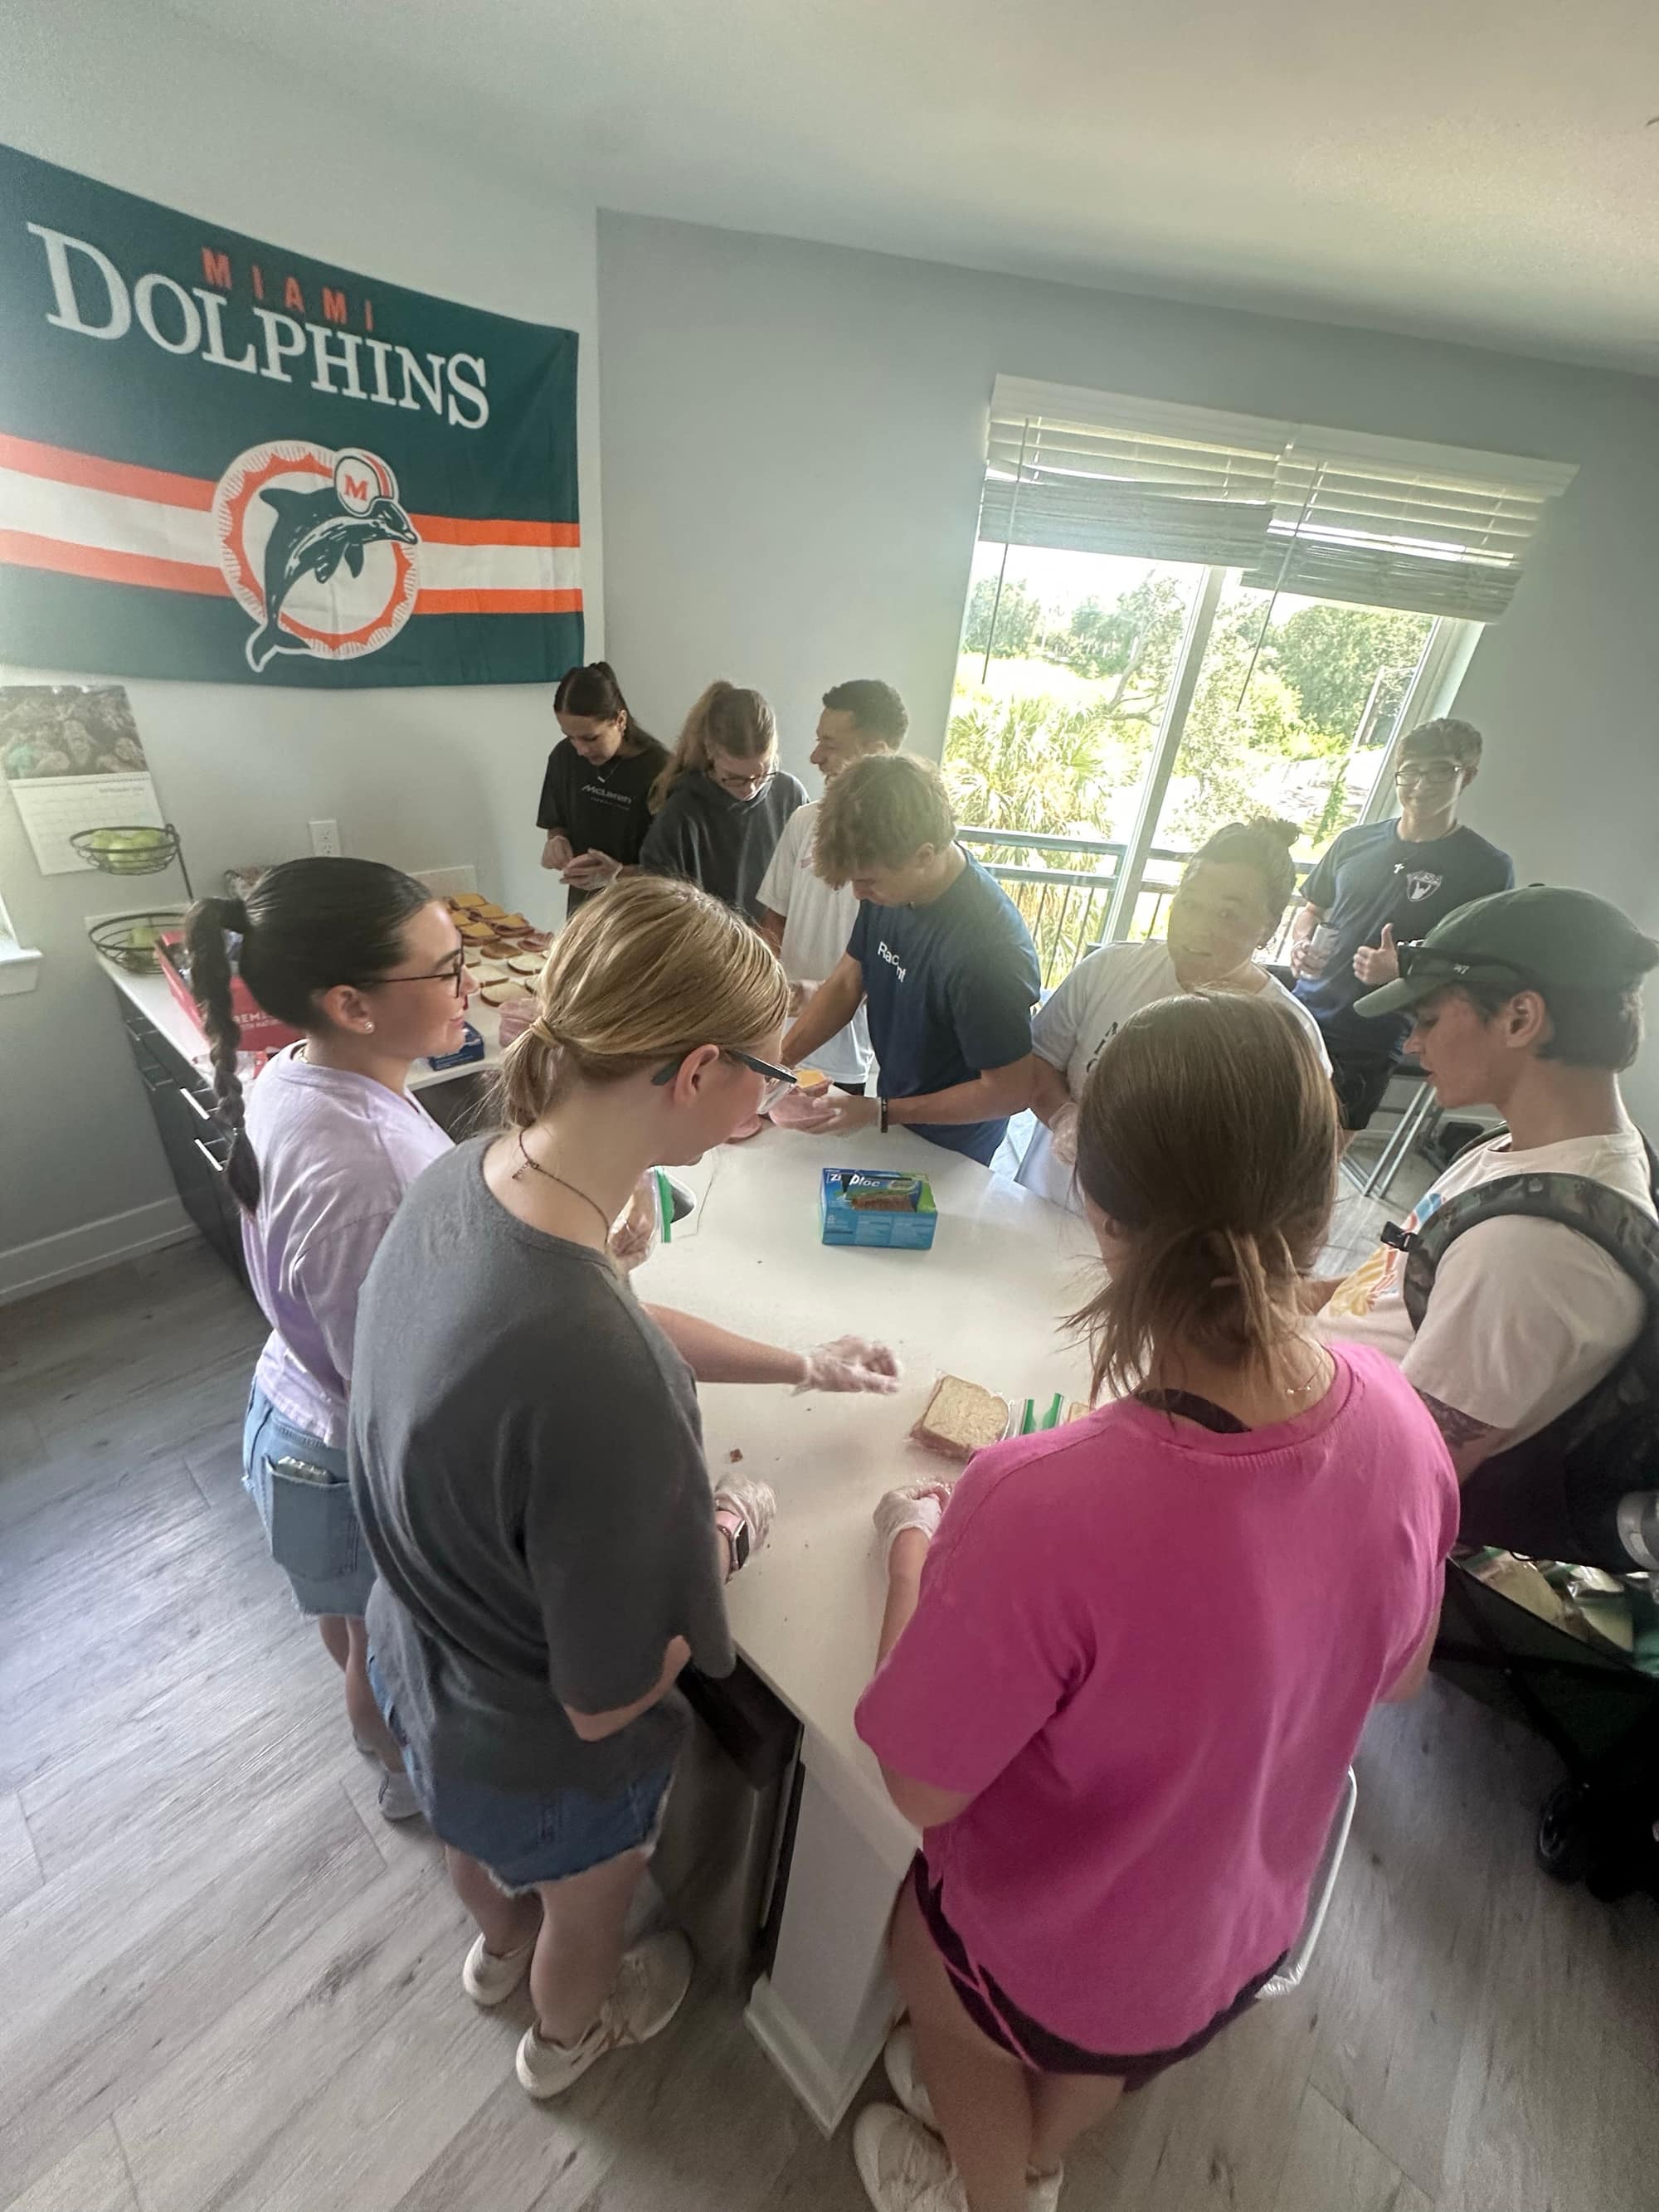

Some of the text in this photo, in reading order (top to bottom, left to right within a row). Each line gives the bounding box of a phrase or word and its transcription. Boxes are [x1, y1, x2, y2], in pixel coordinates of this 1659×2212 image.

[27, 222, 489, 430] DOLPHINS
[202, 246, 373, 332] MIAMI
[343, 474, 369, 502] M
